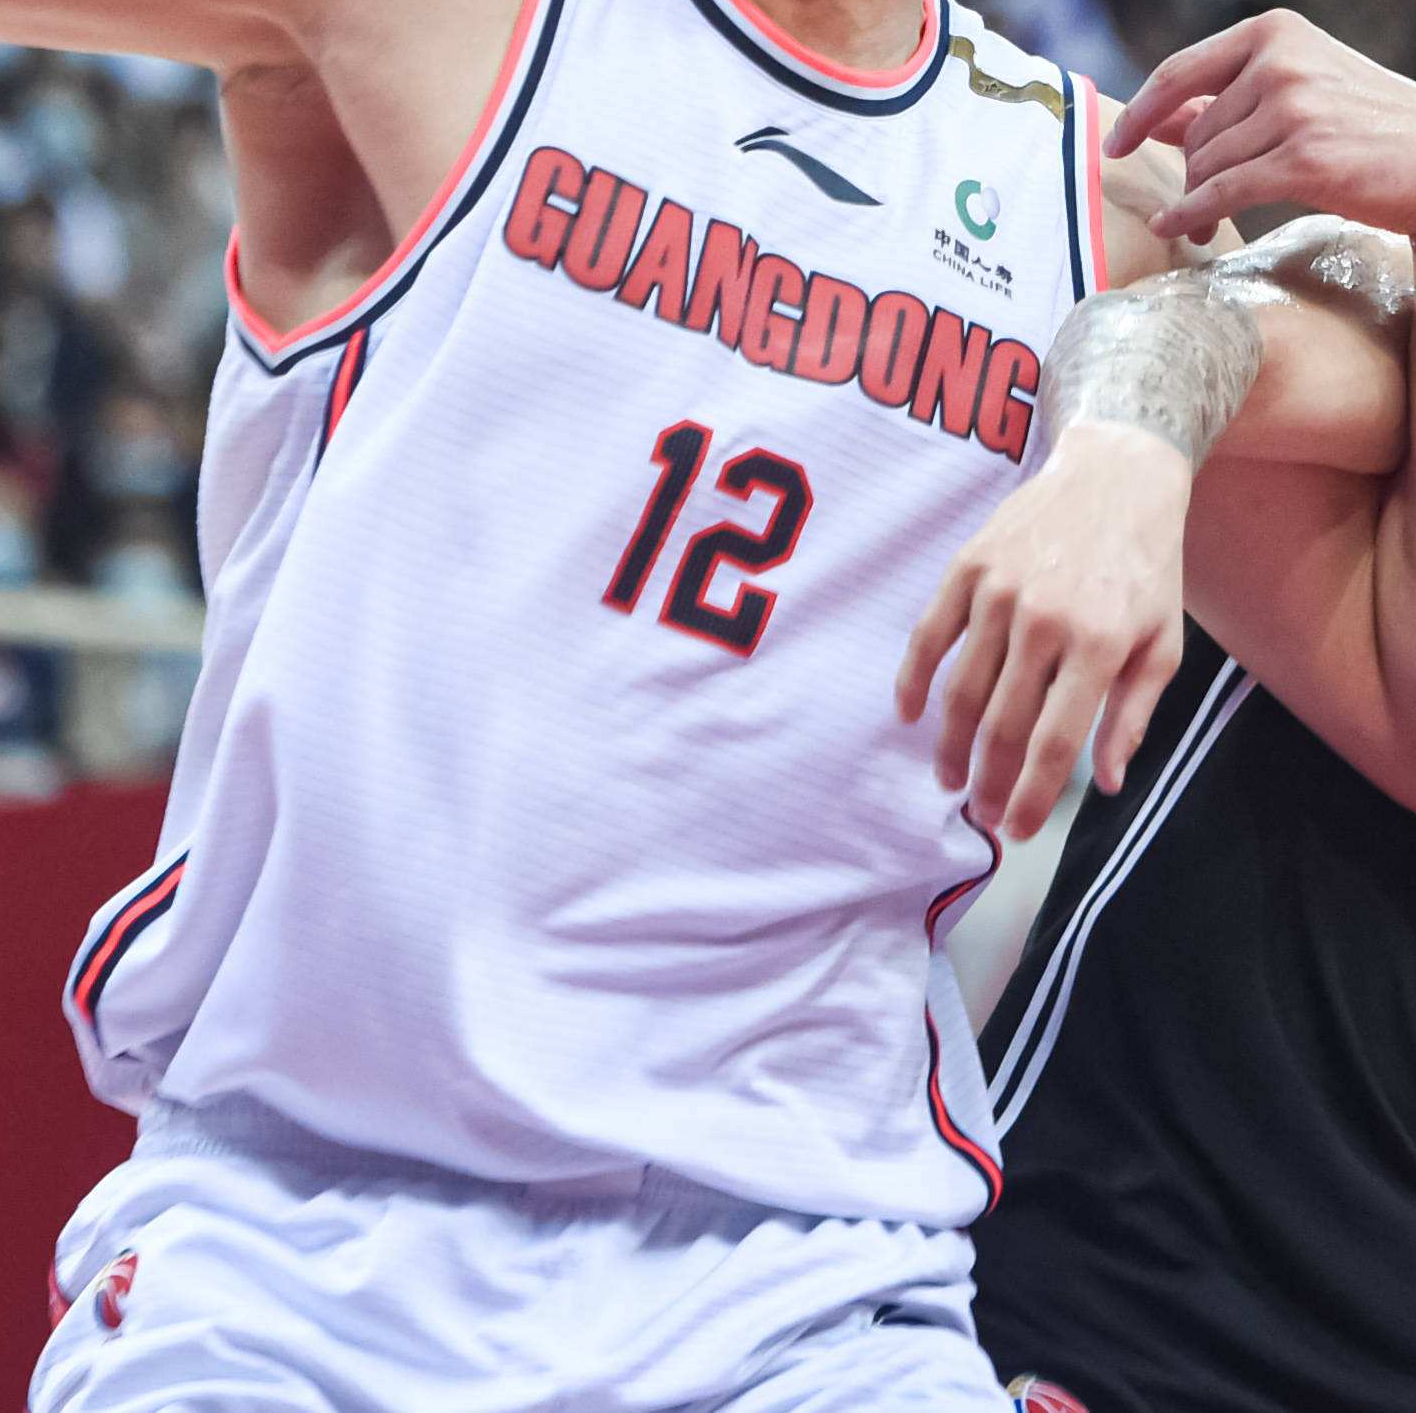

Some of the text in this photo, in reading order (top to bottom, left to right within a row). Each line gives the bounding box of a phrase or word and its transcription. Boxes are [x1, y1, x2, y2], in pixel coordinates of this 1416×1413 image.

[503, 145, 1042, 465] GUANGDONG
[932, 248, 975, 283] CHINA
[601, 419, 814, 659] 12
